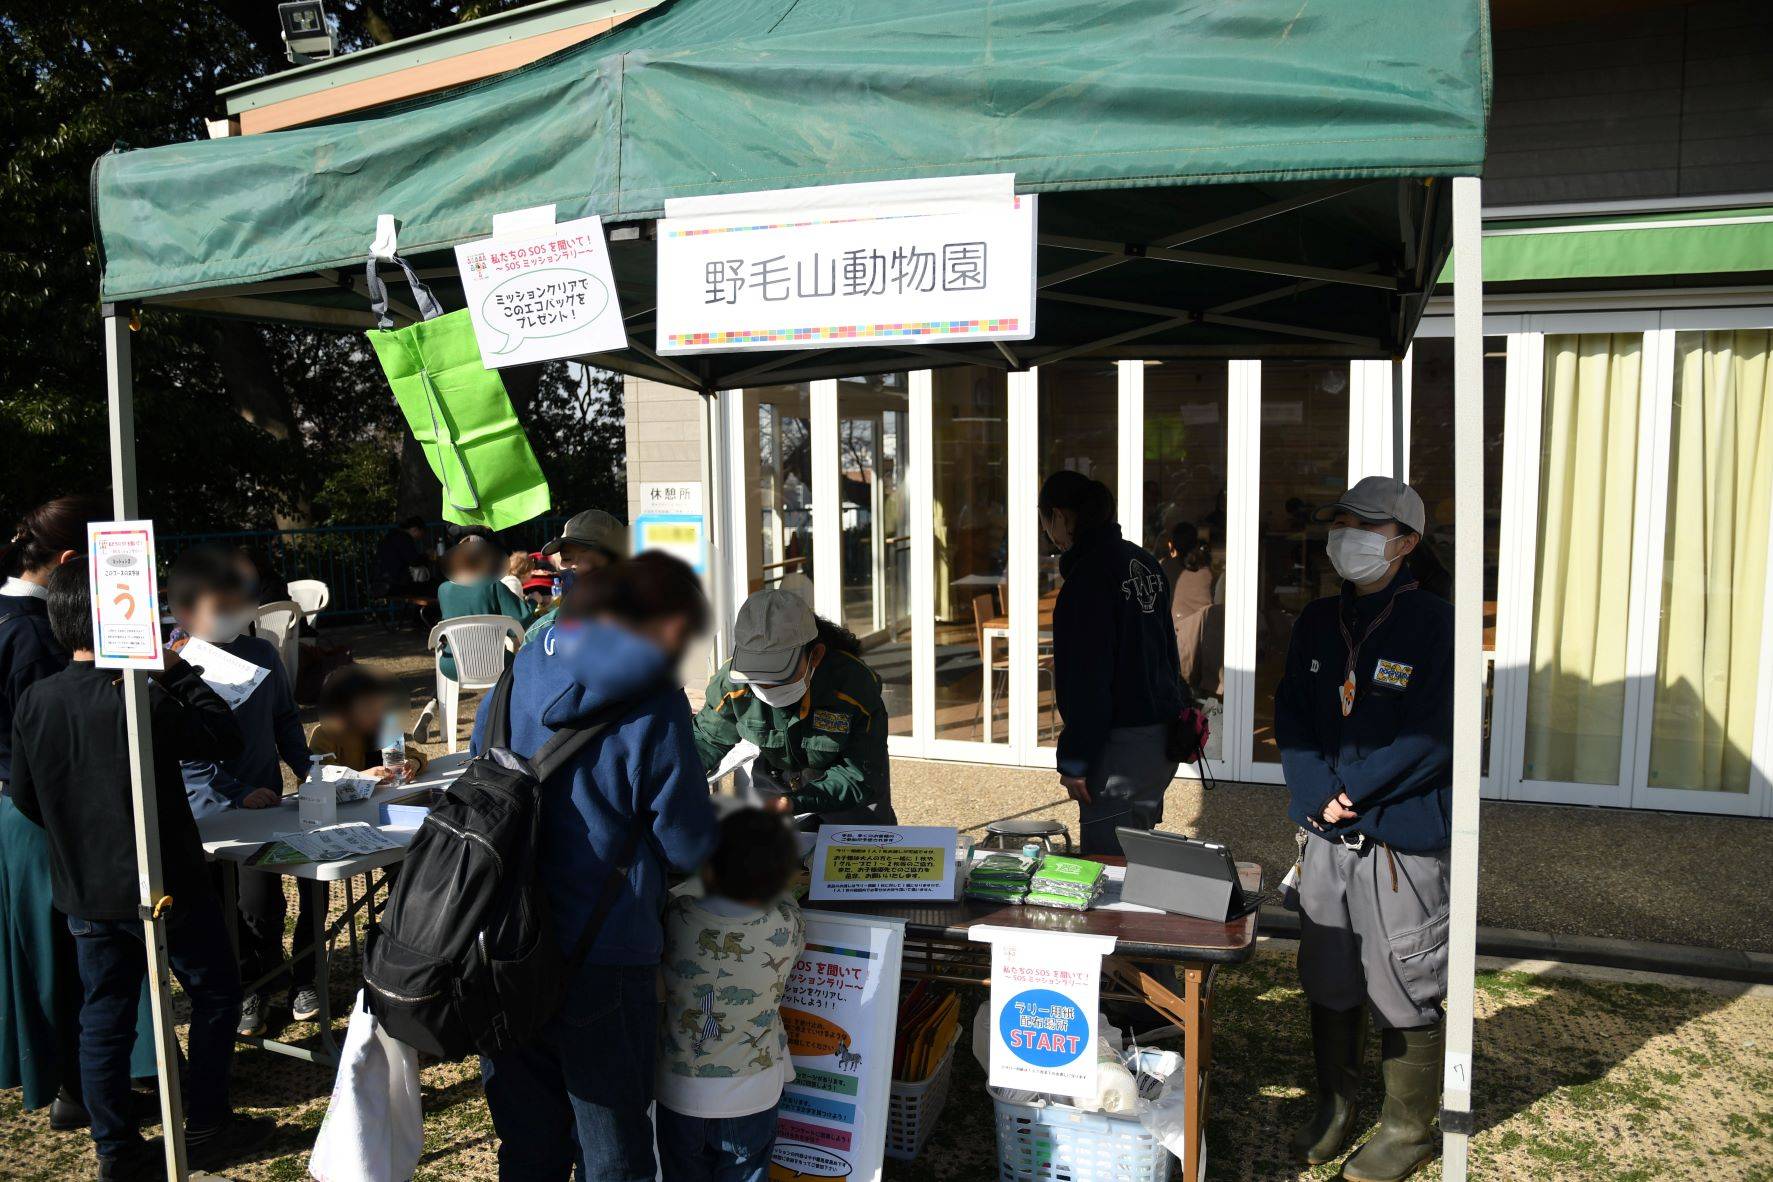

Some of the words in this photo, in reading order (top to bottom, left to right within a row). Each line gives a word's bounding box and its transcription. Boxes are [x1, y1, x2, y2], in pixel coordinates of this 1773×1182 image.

[705, 241, 987, 305] 野毛山動物園
[496, 278, 589, 305] ミッションクリアで
[504, 293, 586, 318] このエコバッグを
[516, 310, 577, 329] プレゼント！
[650, 487, 691, 500] 休憩所
[1121, 574, 1163, 601] STAFF
[113, 583, 135, 621] う
[1014, 1001, 1075, 1020] ラリー用紙
[1020, 1015, 1069, 1032] 配布場所
[1010, 1028, 1081, 1055] START
